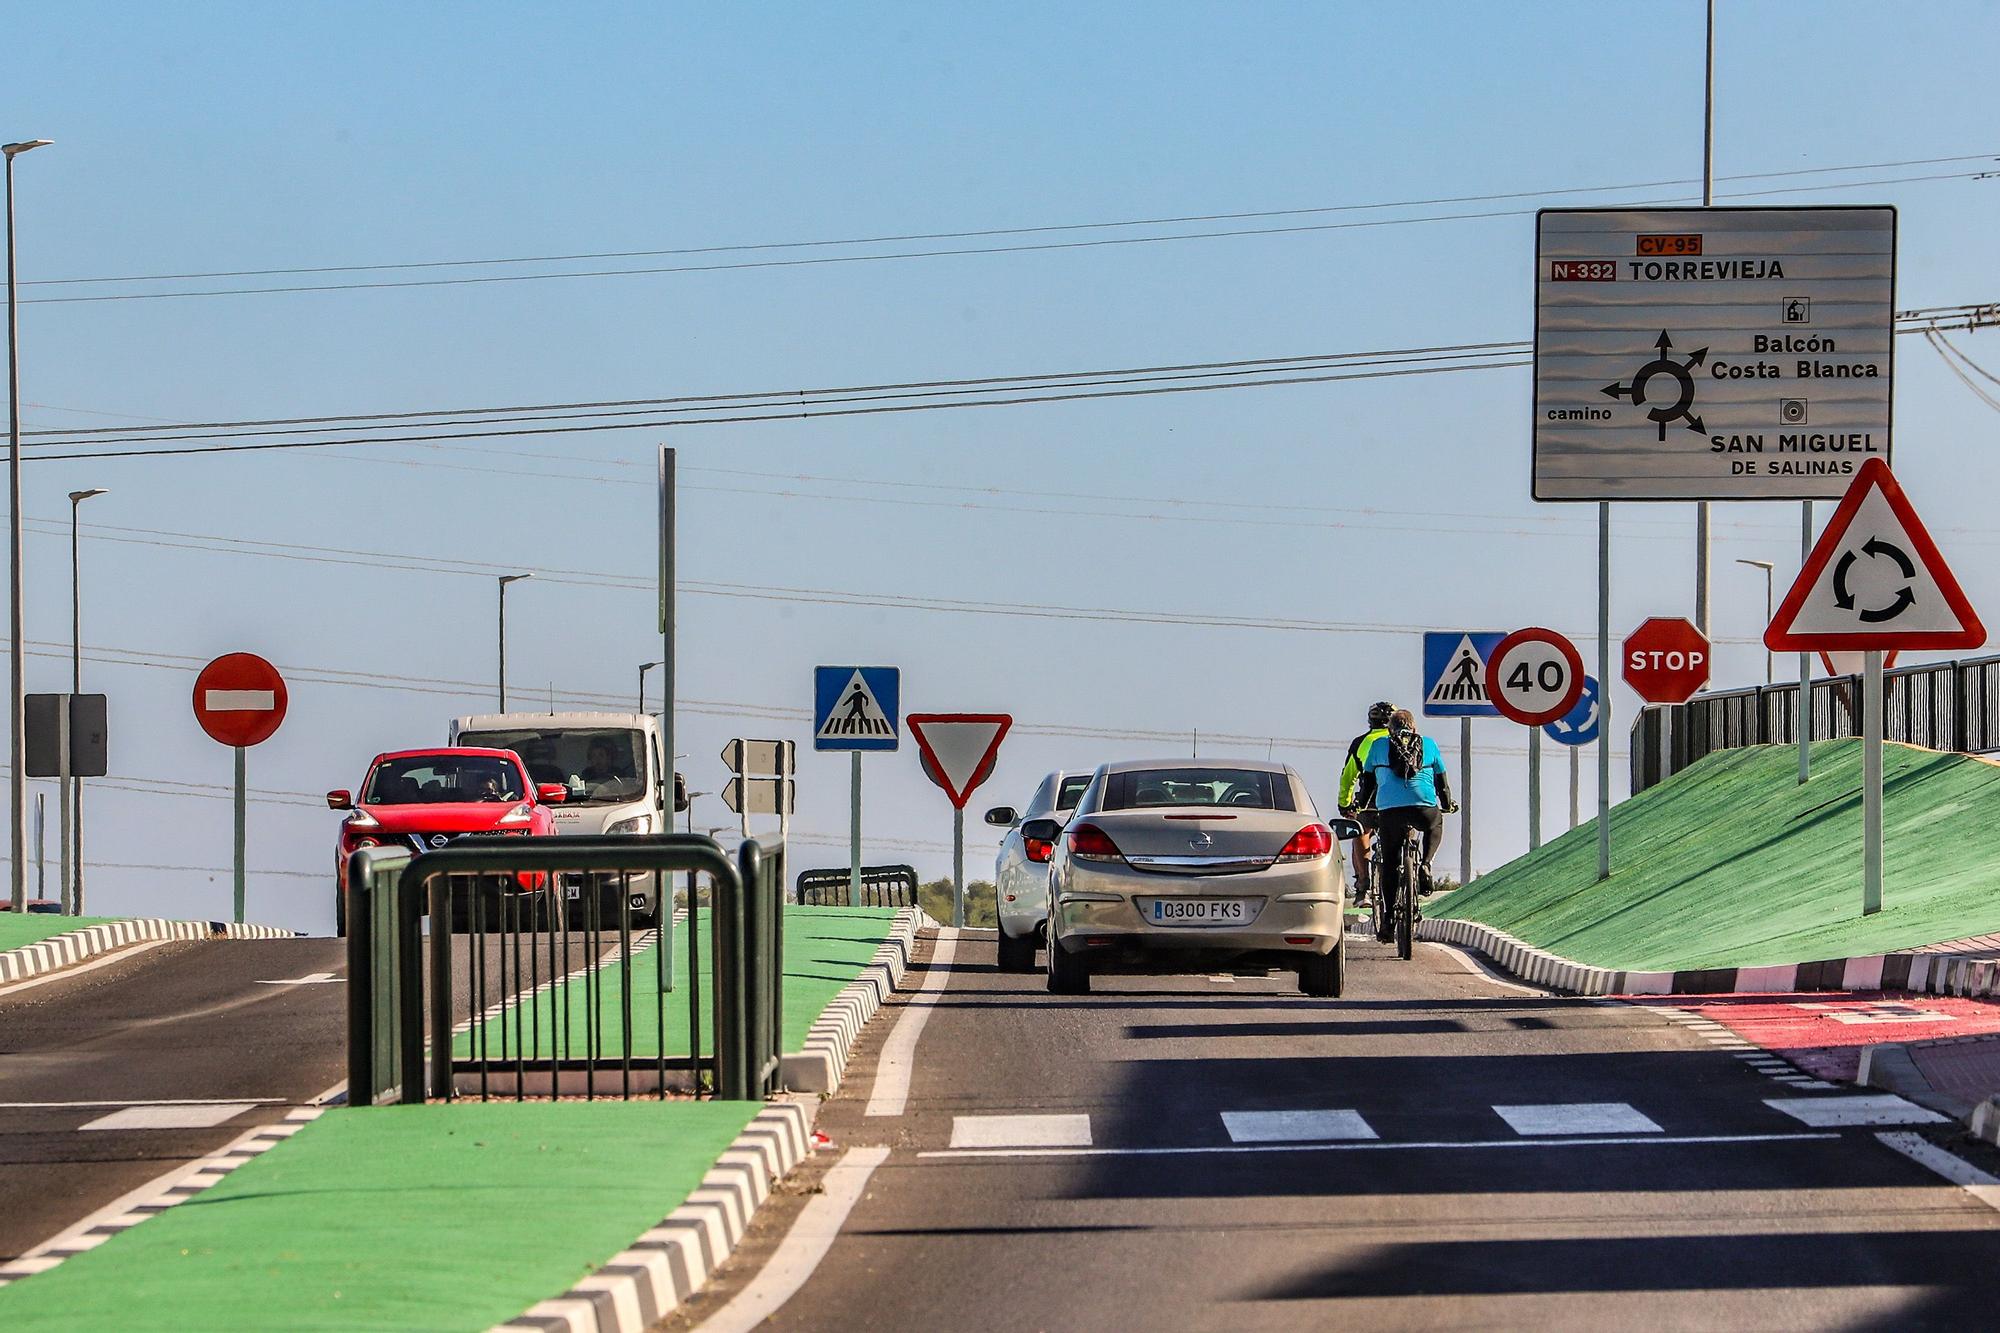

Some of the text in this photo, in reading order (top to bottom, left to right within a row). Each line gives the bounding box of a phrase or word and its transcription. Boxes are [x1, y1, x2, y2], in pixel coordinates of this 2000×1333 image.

[1639, 238, 1698, 253] CV-95
[1554, 260, 1784, 281] N-332 TORREVIEJA
[1754, 334, 1835, 353] Balcón
[1711, 361, 1878, 379] Costa Blanca
[1547, 407, 1612, 420] camino
[1710, 434, 1877, 453] SAN MIGUEL
[1731, 460, 1853, 475] DE SALINAS
[1630, 651, 1704, 671] STOP
[1506, 661, 1564, 692] 40
[1164, 902, 1241, 918] 0300 FKS
